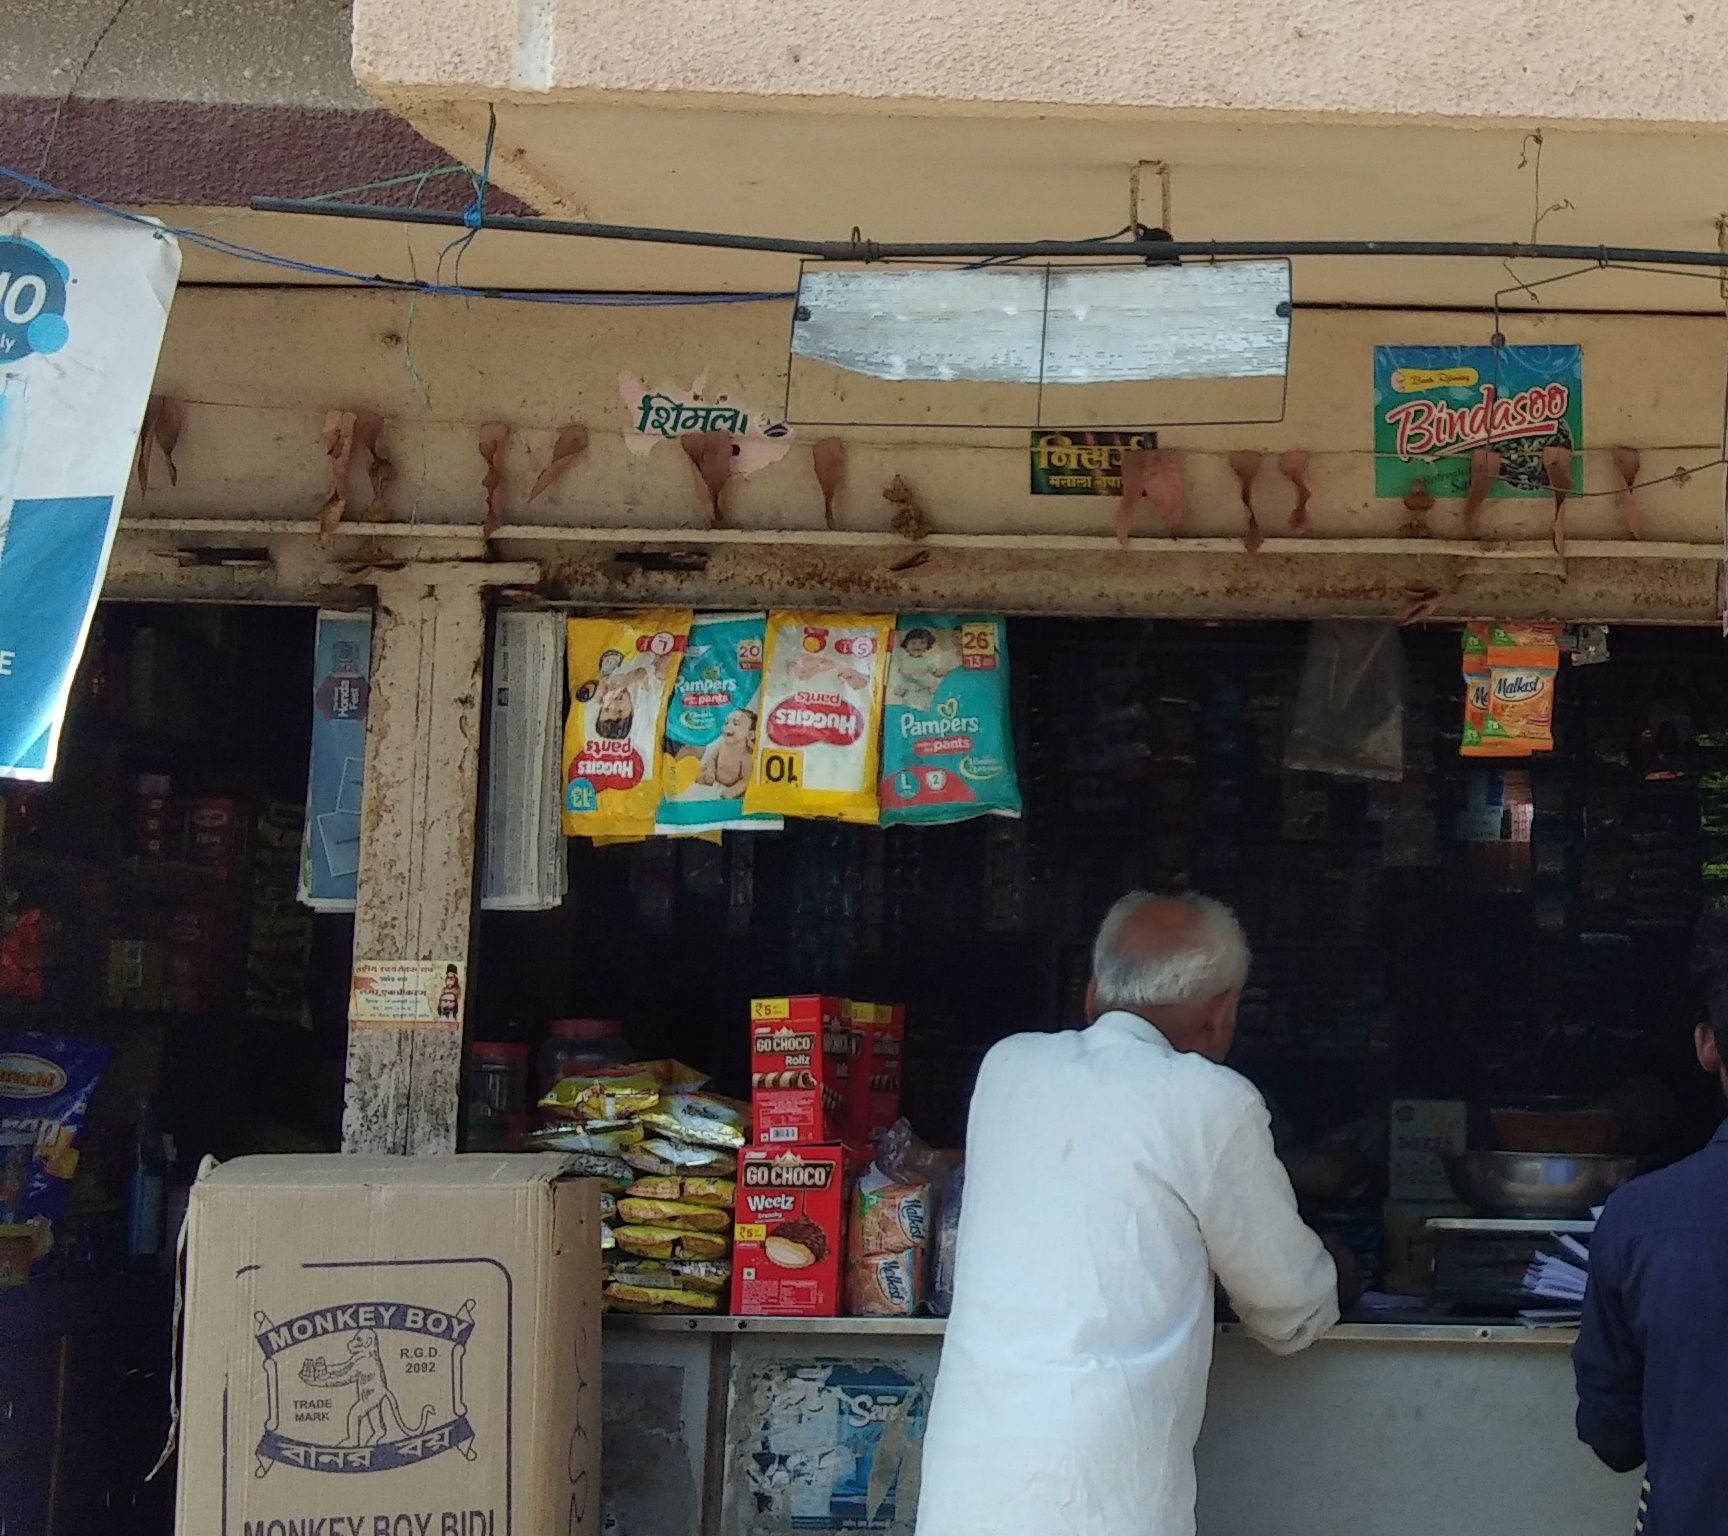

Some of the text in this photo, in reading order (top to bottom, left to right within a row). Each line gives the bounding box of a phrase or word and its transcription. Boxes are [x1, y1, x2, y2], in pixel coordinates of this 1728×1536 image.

[1386, 383, 1568, 462] Bindasoo
[963, 631, 988, 651] 26
[739, 644, 761, 658] 20
[901, 712, 979, 738] Pampers
[586, 737, 633, 756] pants
[756, 1039, 772, 1052] GO
[773, 1037, 810, 1051] CHOCO
[746, 1166, 826, 1185] GO CHOCO
[267, 1305, 470, 1351] MONKEY BOY
[400, 1347, 442, 1358] R.G.D.
[405, 1362, 436, 1373] 2092
[293, 1399, 332, 1410] TRADE
[295, 1411, 330, 1422] MARK
